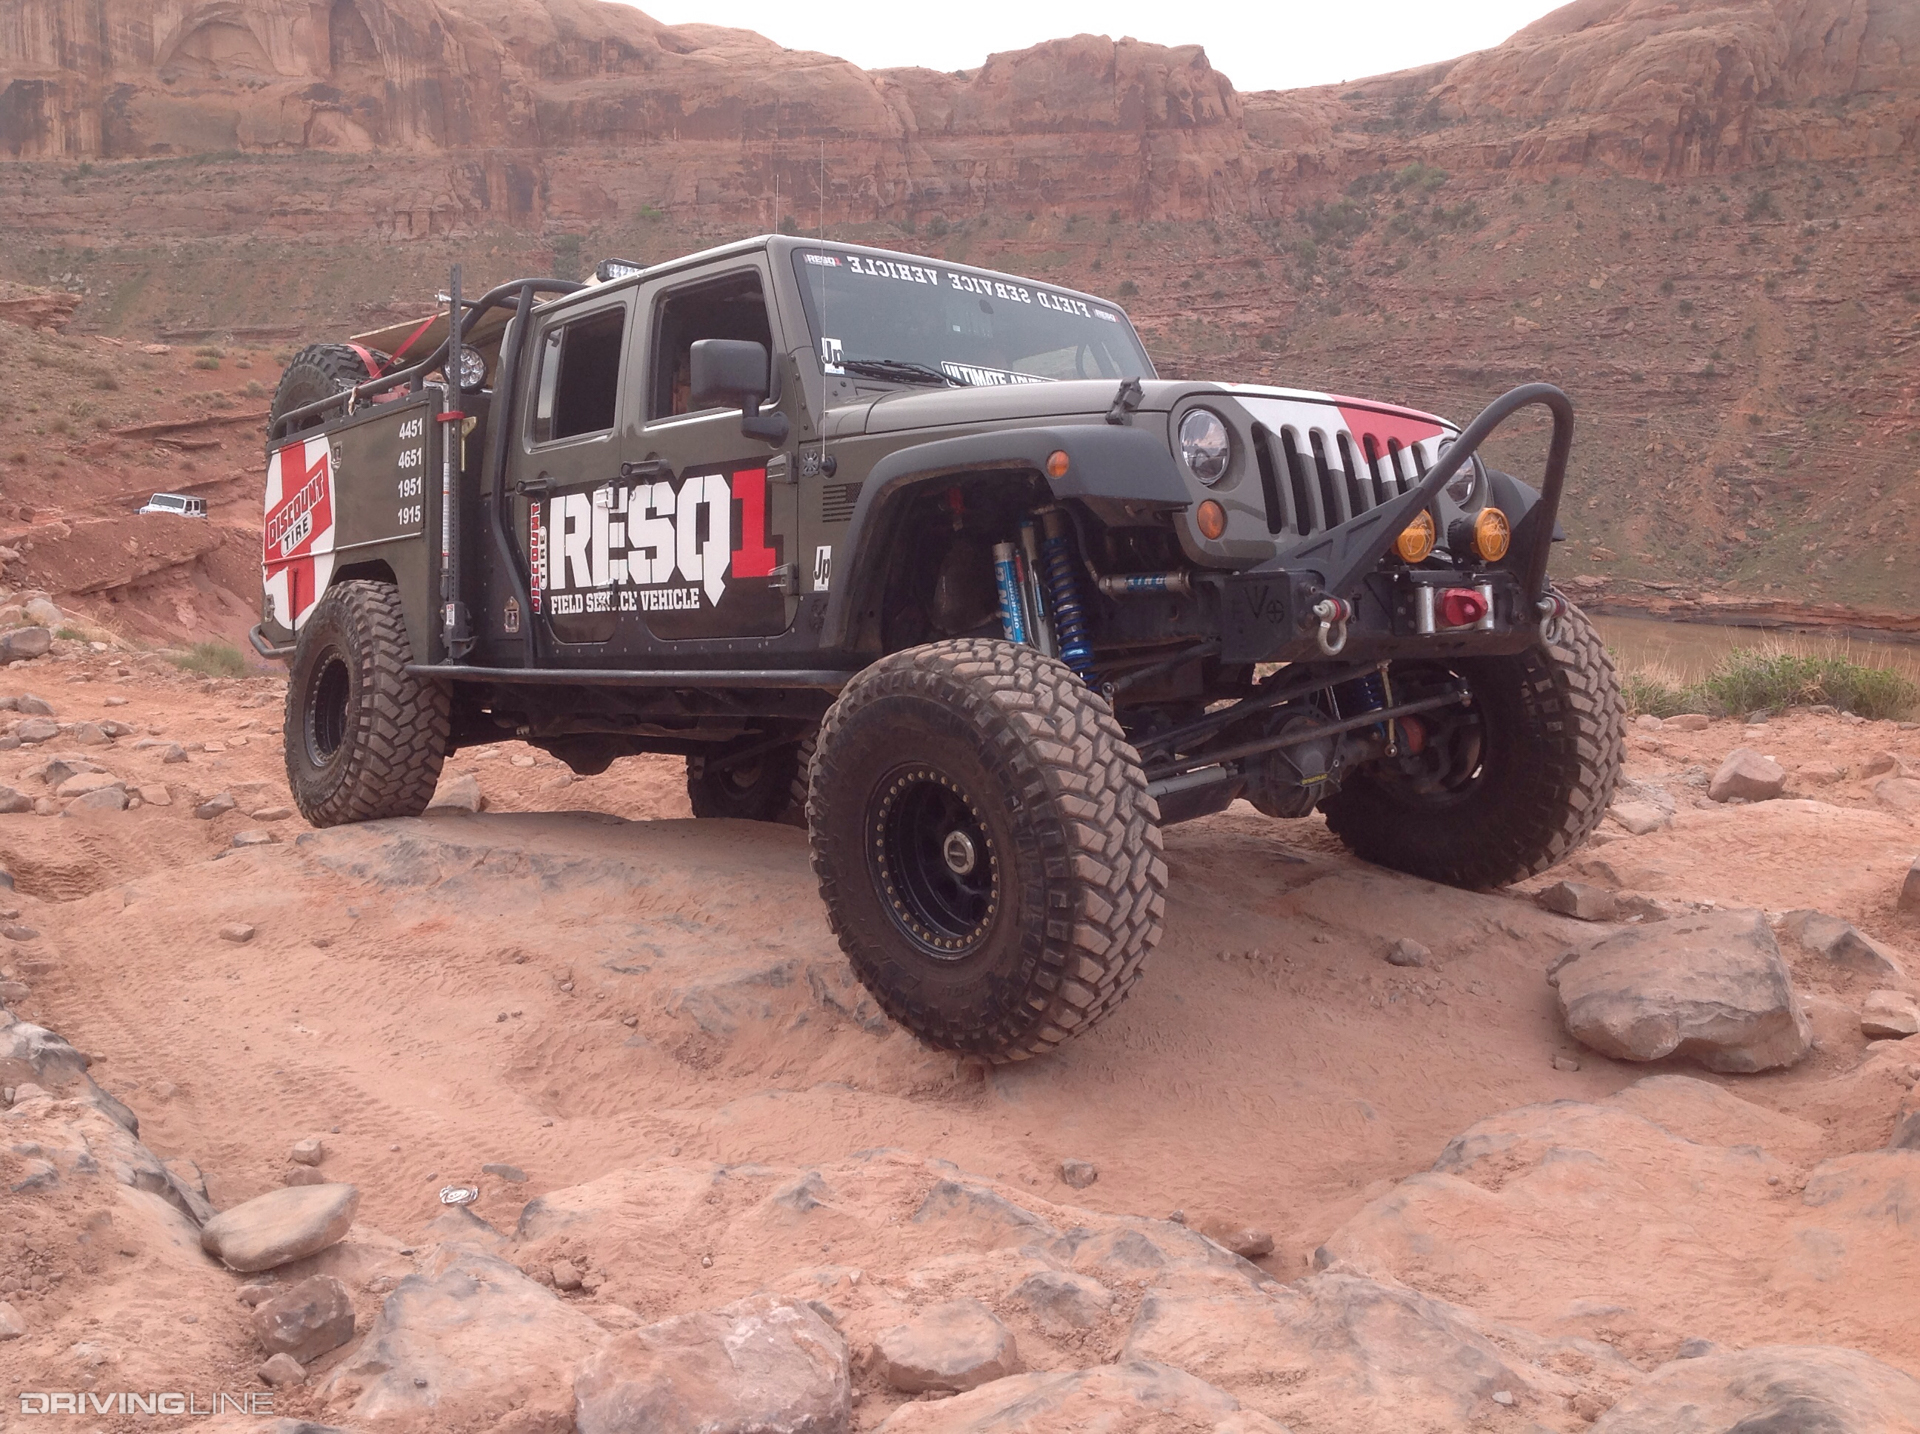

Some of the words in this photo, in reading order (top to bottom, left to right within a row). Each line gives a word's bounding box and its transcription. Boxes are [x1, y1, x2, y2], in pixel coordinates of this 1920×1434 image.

[399, 418, 423, 440] 4451
[398, 447, 422, 469] 4651
[397, 476, 421, 498] 1951
[268, 469, 324, 549] DISCOUNT
[397, 505, 421, 525] 1915
[284, 516, 309, 550] TIRE
[531, 502, 541, 614] DISCOUNT
[813, 549, 831, 585] Jp
[551, 594, 584, 614] FIELD
[586, 591, 637, 612] SERCE
[640, 588, 700, 611] VEHICLE
[995, 566, 1014, 640] KING
